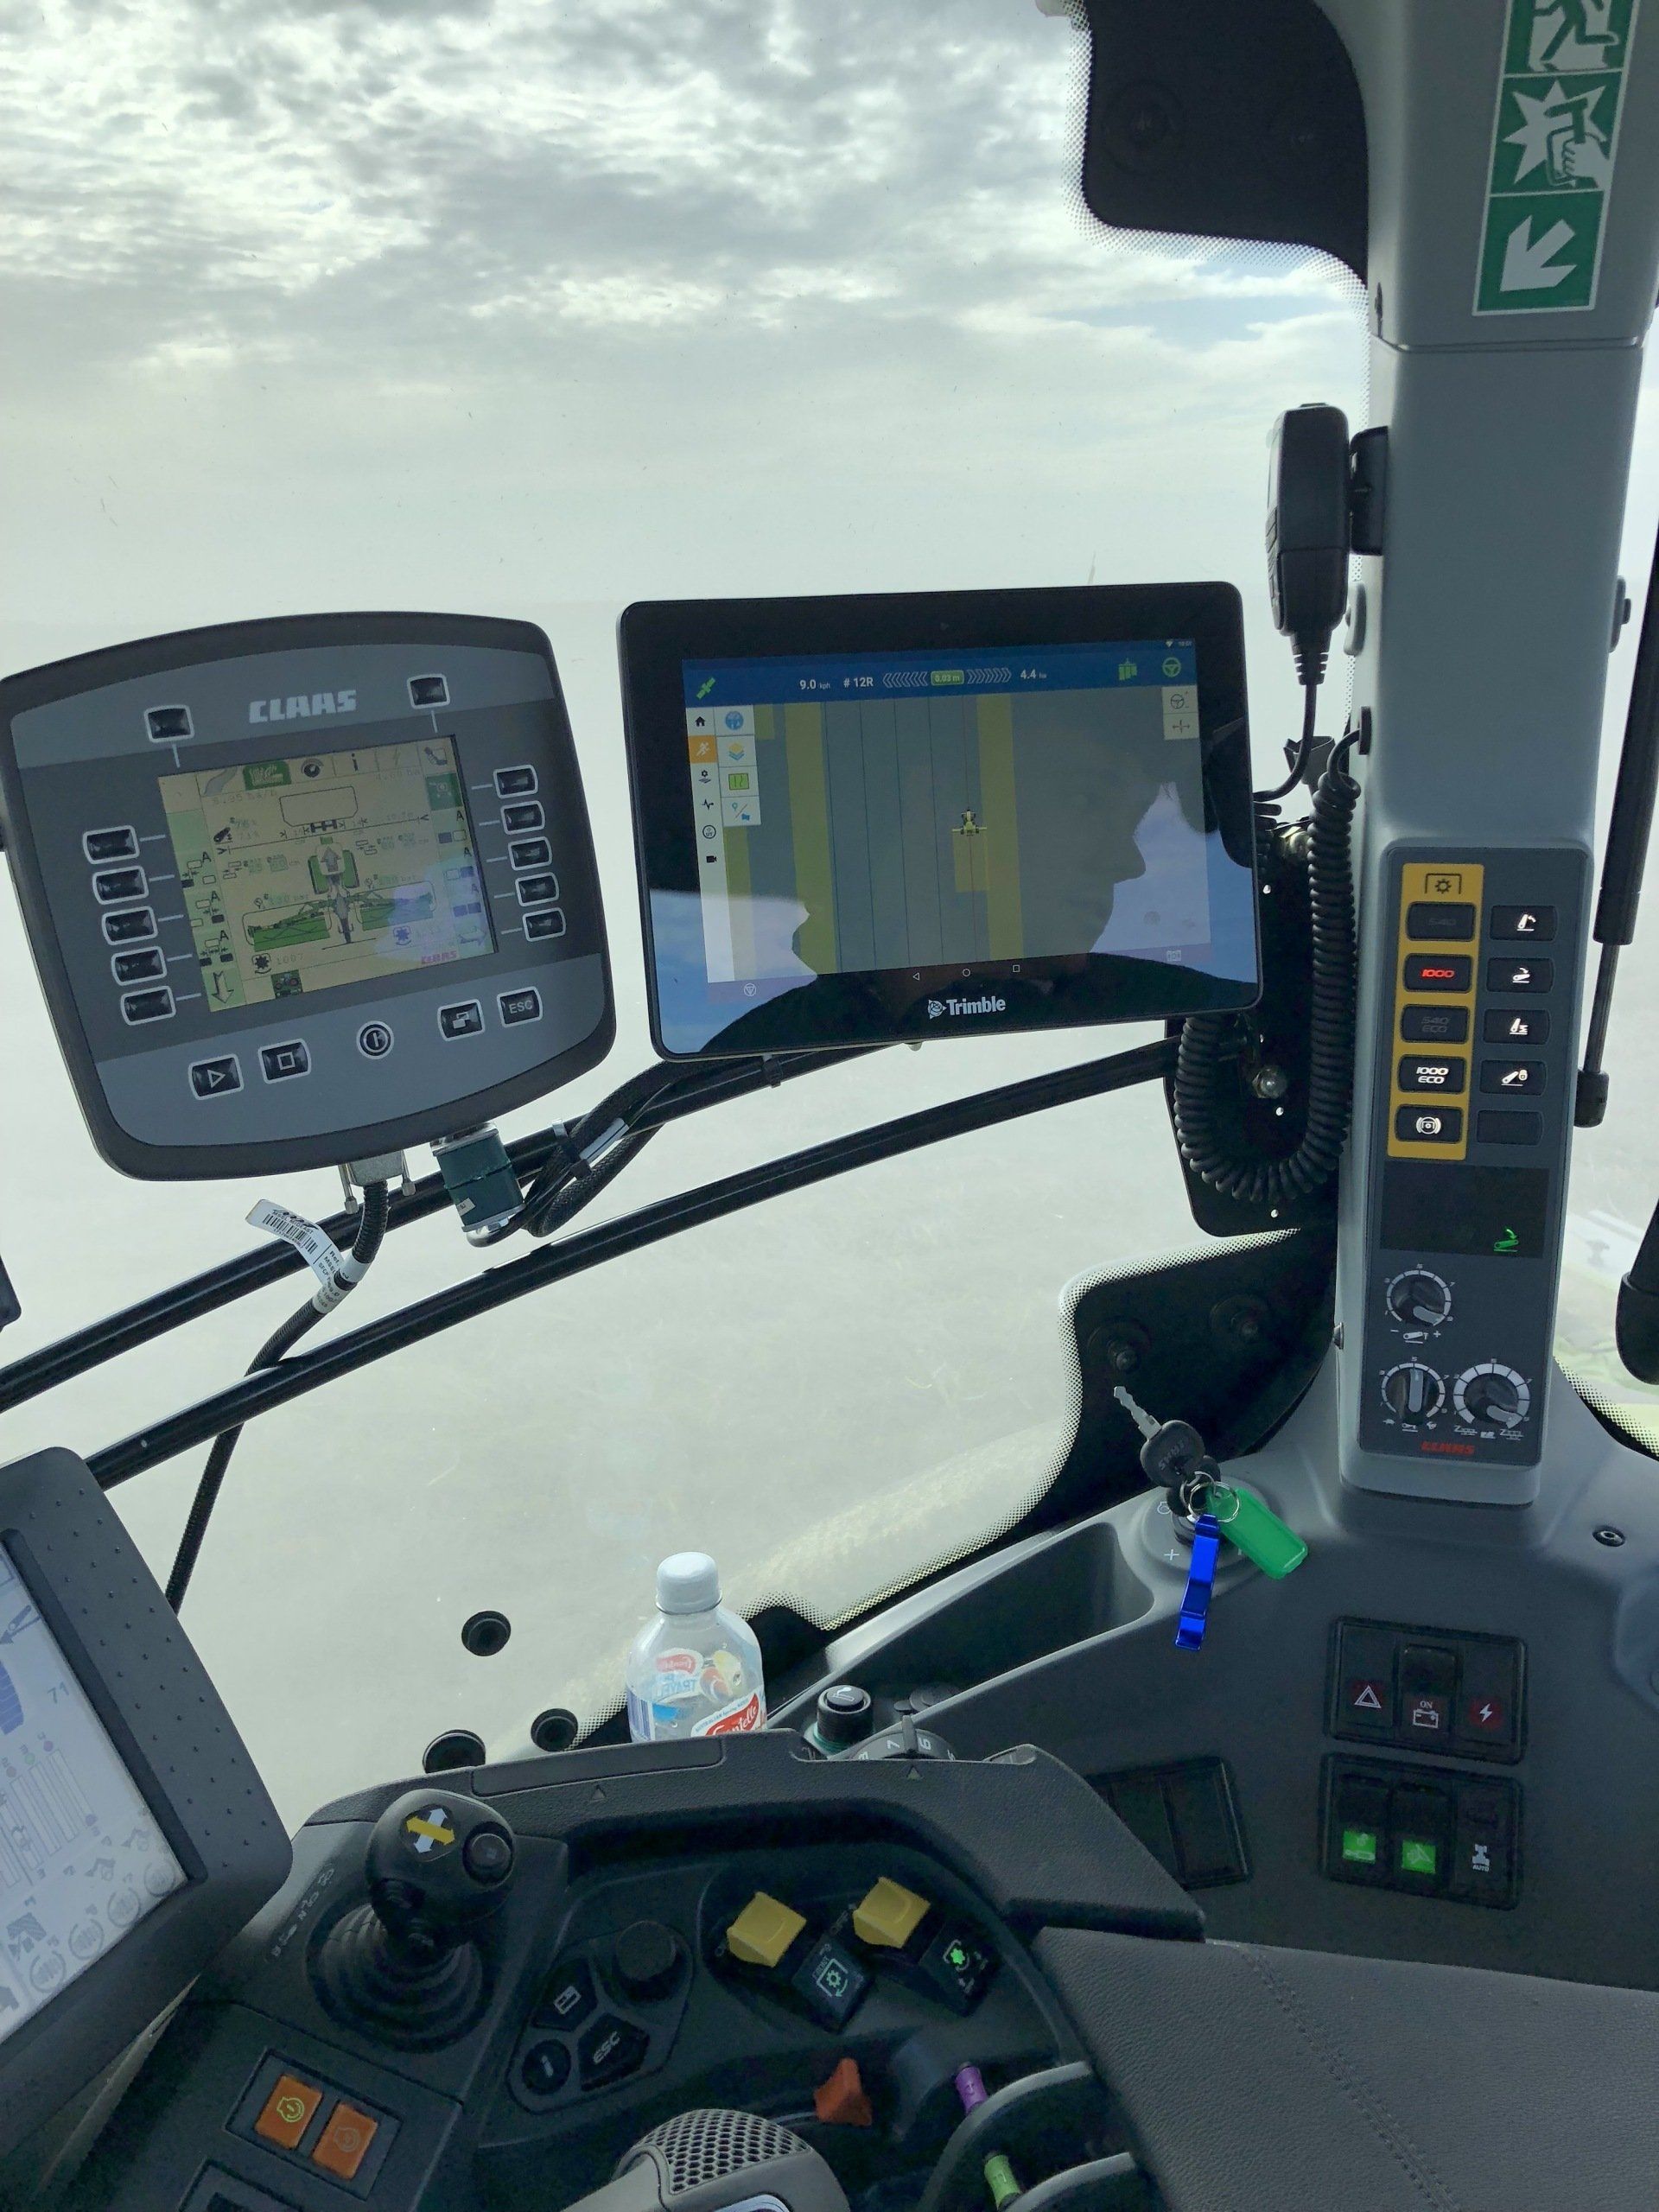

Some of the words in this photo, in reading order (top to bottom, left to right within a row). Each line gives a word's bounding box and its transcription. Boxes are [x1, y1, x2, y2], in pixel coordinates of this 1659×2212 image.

[934, 674, 951, 683] 0.03
[1020, 668, 1037, 680] 4.4
[799, 679, 817, 690] 9.0
[819, 682, 831, 690] kph
[843, 677, 850, 689] #
[854, 677, 874, 688] 12R
[249, 690, 357, 724] CLAAS
[202, 851, 212, 862] A
[211, 890, 220, 902] A
[219, 930, 229, 941] A
[1420, 967, 1456, 980] 1000
[508, 1000, 533, 1014] ESC
[945, 995, 1007, 1016] Trimble
[1415, 1066, 1450, 1076] 1000
[1417, 1076, 1446, 1084] ECO
[48, 1681, 69, 1704] 71
[1420, 1700, 1433, 1709] ON
[887, 1739, 900, 1750] 7
[918, 1737, 932, 1751] 6
[1472, 1864, 1490, 1872] AUTO
[593, 2031, 620, 2065] ESC
